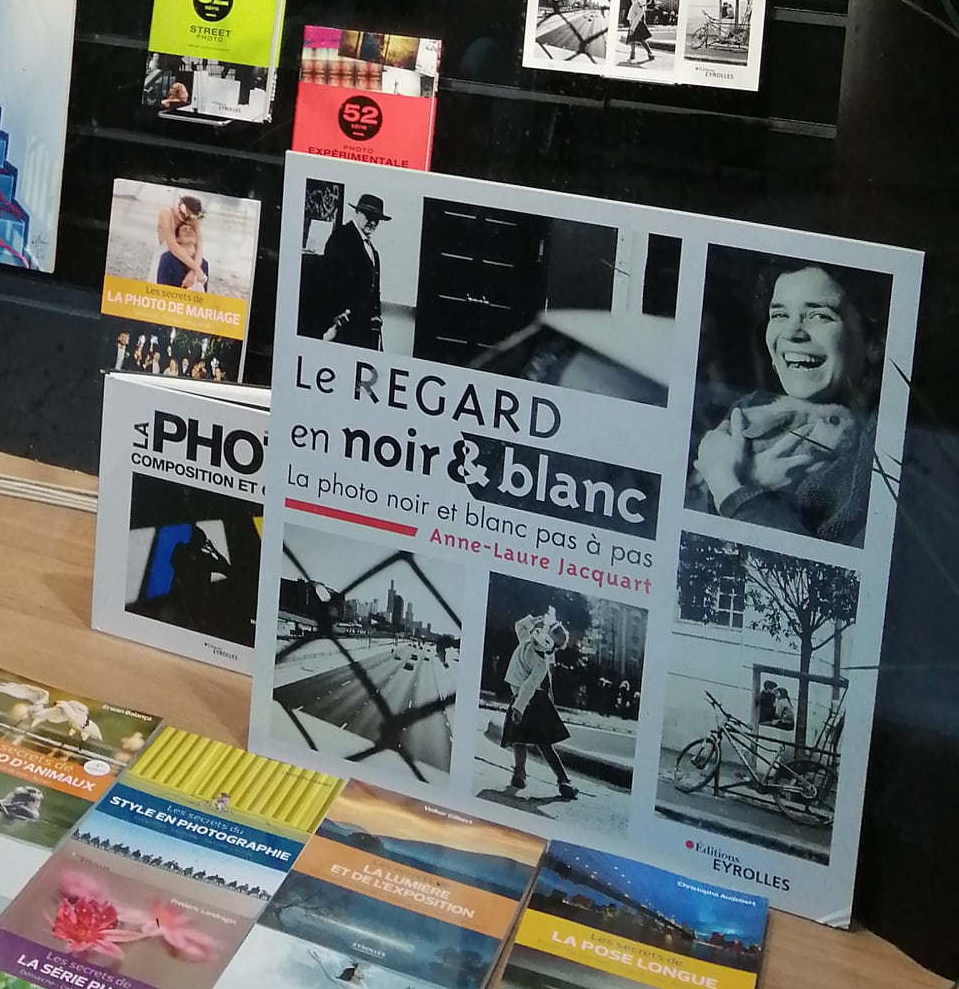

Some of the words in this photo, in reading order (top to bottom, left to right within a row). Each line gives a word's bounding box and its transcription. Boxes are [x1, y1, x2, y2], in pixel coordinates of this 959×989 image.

[190, 25, 232, 38] STREET
[196, 34, 224, 43] PHOTO
[705, 71, 734, 80] EYROLLES
[342, 103, 379, 125] 52
[308, 146, 410, 168] EXPÉRIMENTALE
[343, 144, 374, 154] PHOTO
[107, 290, 124, 304] LA
[124, 292, 166, 312] PHOTO
[168, 300, 184, 316] DE
[186, 304, 240, 326] MARIAGE
[146, 286, 160, 296] Les
[162, 288, 190, 301] secrets
[193, 293, 204, 304] de
[295, 355, 336, 395] Le
[353, 360, 562, 440] REGARD
[132, 422, 150, 450] LA
[153, 410, 269, 476] PHO
[131, 452, 235, 489] COMPOSITION
[238, 480, 258, 497] ET
[291, 423, 330, 454] en
[342, 426, 440, 477] noir
[446, 434, 491, 488] &
[497, 446, 648, 524] blanc
[287, 463, 309, 489] La
[317, 475, 379, 504] photo
[387, 493, 428, 516] noir
[436, 503, 459, 522] et
[465, 502, 527, 540] blanc
[535, 525, 578, 550] pas
[585, 533, 601, 557] à
[610, 544, 654, 569] pas
[429, 526, 551, 570] Anne-Laure
[557, 557, 653, 596] Jacquart
[0, 742, 52, 767] secrets
[54, 760, 74, 773] de
[8, 758, 96, 792] D'ANIMAUX
[109, 794, 157, 818] STYLE
[155, 812, 178, 826] EN
[176, 818, 292, 862] PHOTOGRAPHIE
[167, 804, 186, 816] Les
[189, 812, 228, 830] secrets
[696, 840, 740, 864] Éditions
[330, 864, 350, 877] ET
[350, 871, 372, 886] DE
[374, 878, 475, 919] L'EXPOSITION
[363, 864, 383, 878] LA
[385, 872, 451, 900] LUMIÈRE
[713, 858, 792, 892] EYROLLES
[552, 931, 578, 948] LA
[580, 940, 634, 965] POSE
[636, 958, 719, 989] LONGUE
[590, 932, 614, 946] Les
[616, 940, 664, 962] secrets
[666, 954, 683, 968] de
[16, 954, 40, 971] LA
[40, 966, 88, 988] SÉRIE
[46, 950, 67, 966] Les
[70, 960, 113, 983] secrets
[115, 976, 132, 989] de
